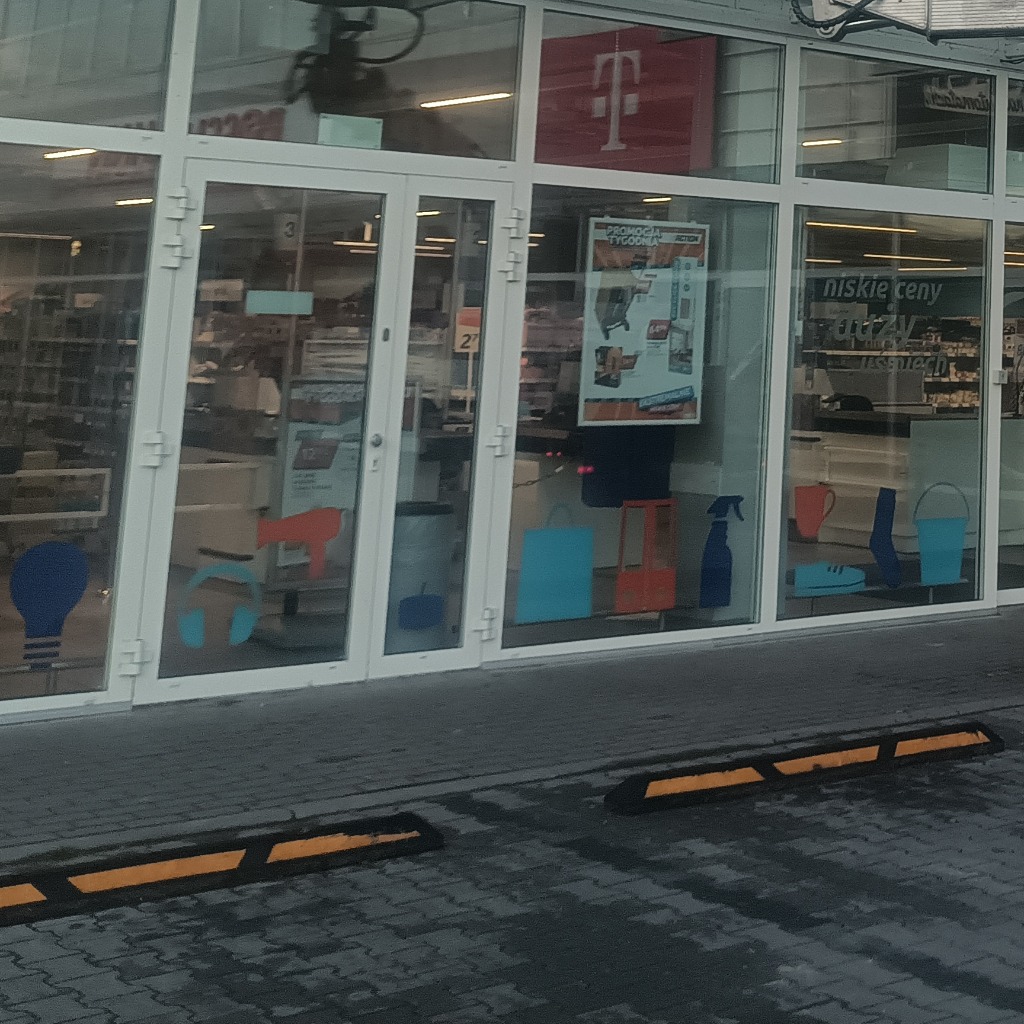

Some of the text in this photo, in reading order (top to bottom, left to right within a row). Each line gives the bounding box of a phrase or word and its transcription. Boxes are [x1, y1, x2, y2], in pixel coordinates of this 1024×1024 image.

[606, 226, 661, 238] PROMOCJA
[608, 236, 660, 247] TYGODNIA
[823, 273, 943, 306] niskie ceny
